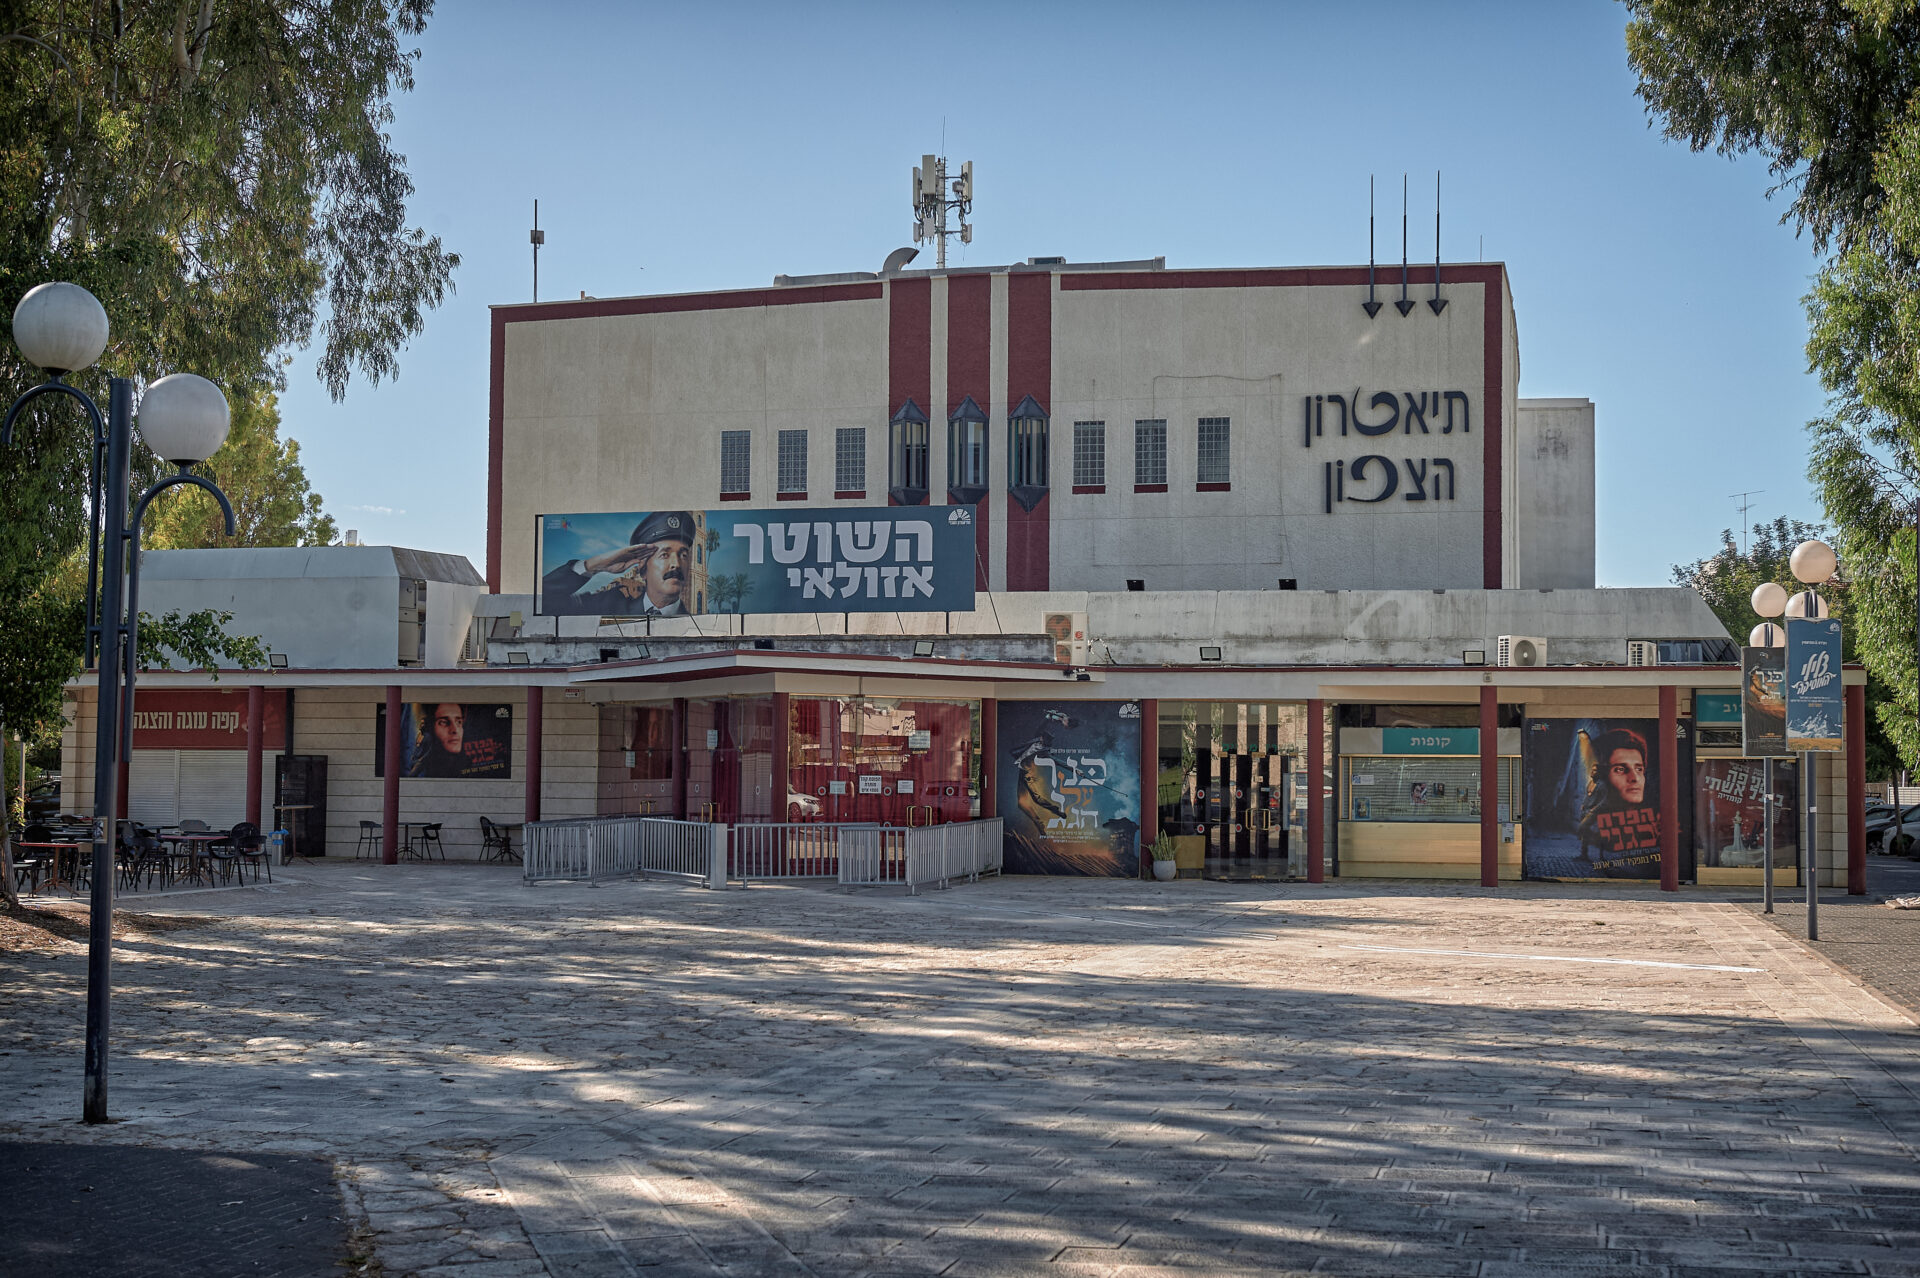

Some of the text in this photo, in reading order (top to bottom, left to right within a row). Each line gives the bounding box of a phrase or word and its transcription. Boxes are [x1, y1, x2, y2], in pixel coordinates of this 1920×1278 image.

[1305, 386, 1470, 448] תיאטרון
[1326, 454, 1455, 514] הצפון
[733, 520, 934, 564] השוטר
[787, 561, 935, 600] אזולאי
[133, 711, 240, 734] קפה עוגה והצגה
[1410, 737, 1452, 749] קופות
[1034, 755, 1107, 789] כנר
[1727, 769, 1749, 786] פה
[1057, 770, 1094, 816] על
[1705, 775, 1746, 798] אשתי
[1717, 792, 1743, 804] קומדיה
[1597, 808, 1656, 829] הפרח
[1600, 823, 1657, 851] בגני
[1612, 858, 1625, 867] זוהר
[1626, 856, 1650, 866] בתפקיד
